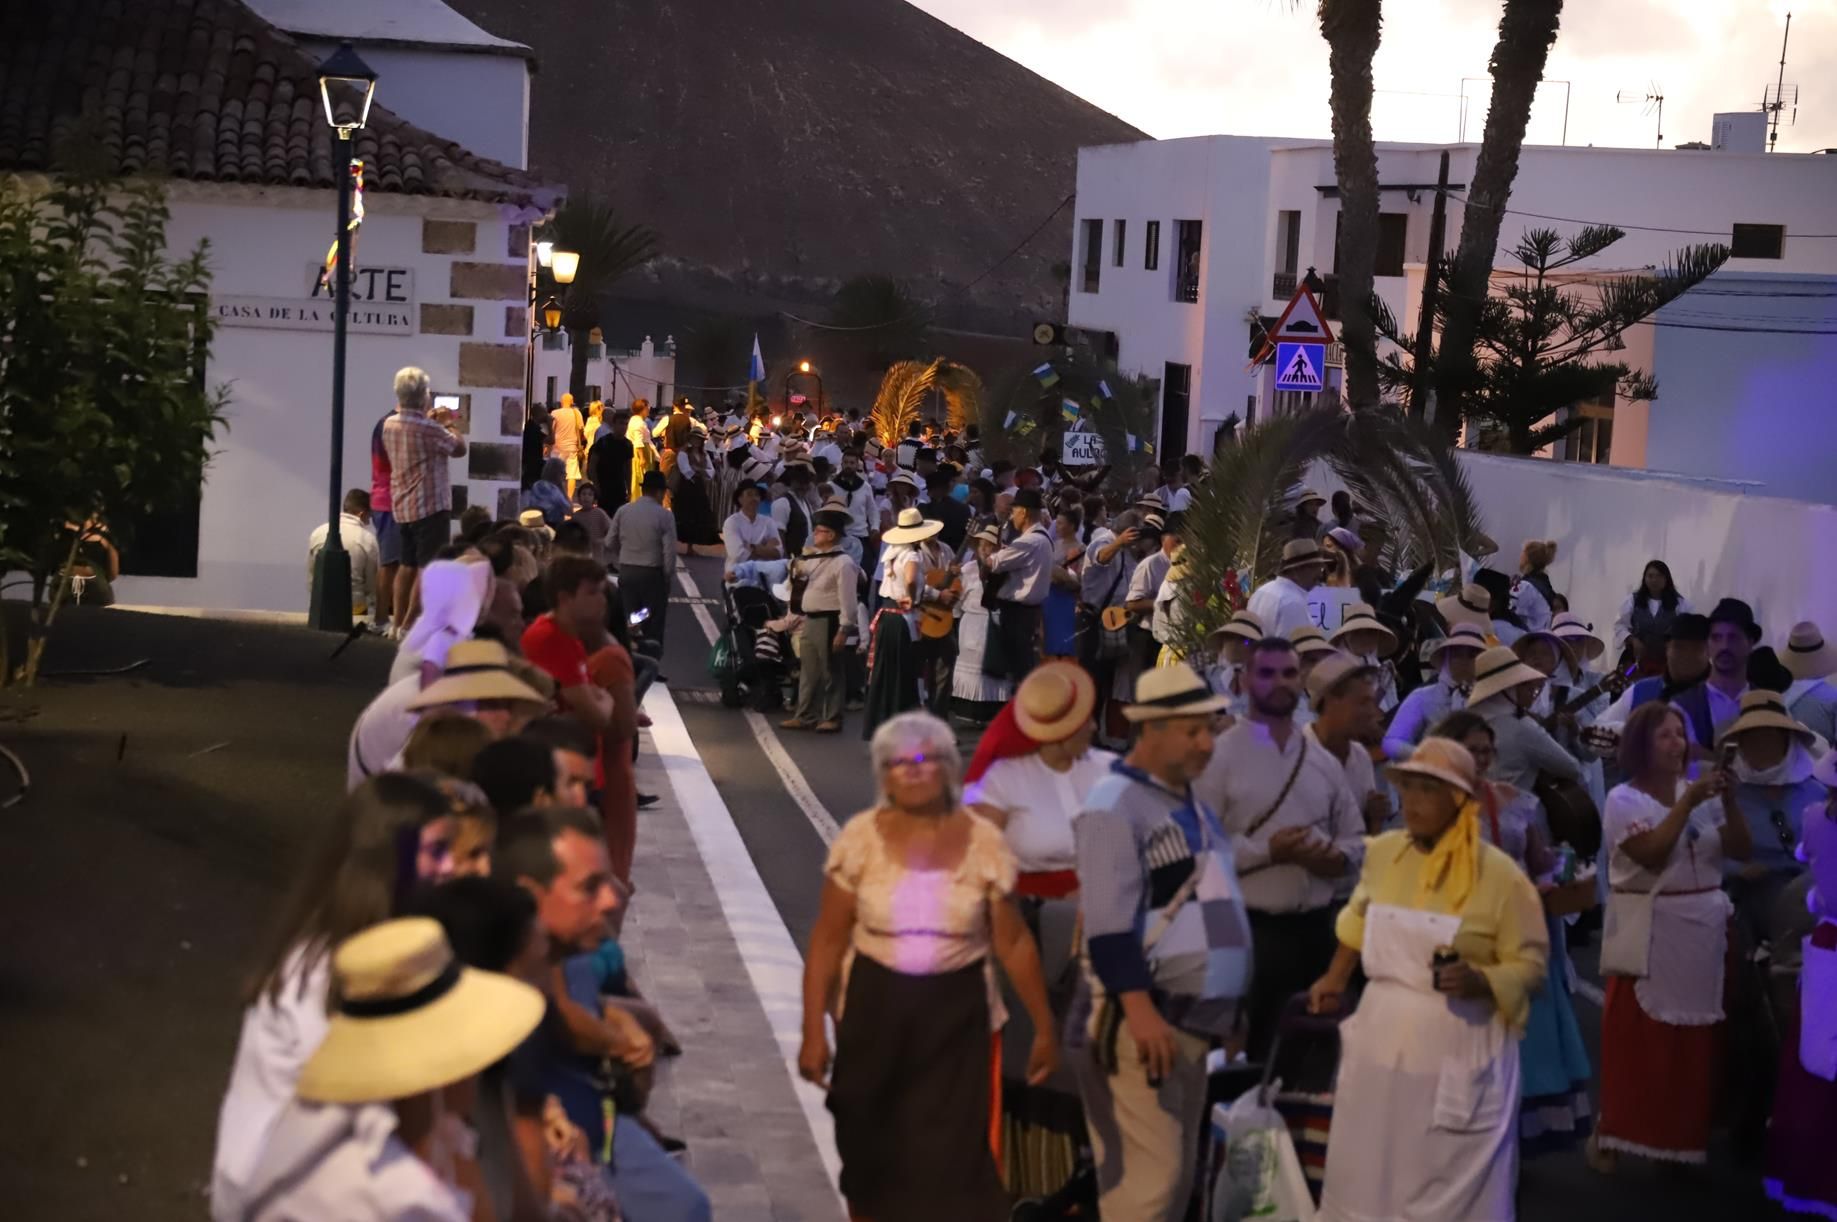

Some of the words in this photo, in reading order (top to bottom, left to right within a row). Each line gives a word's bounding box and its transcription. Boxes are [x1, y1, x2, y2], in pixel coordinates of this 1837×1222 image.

[219, 305, 261, 319] CASA
[269, 307, 291, 320] DE
[300, 309, 319, 321] LA
[329, 311, 409, 326] CLTURA
